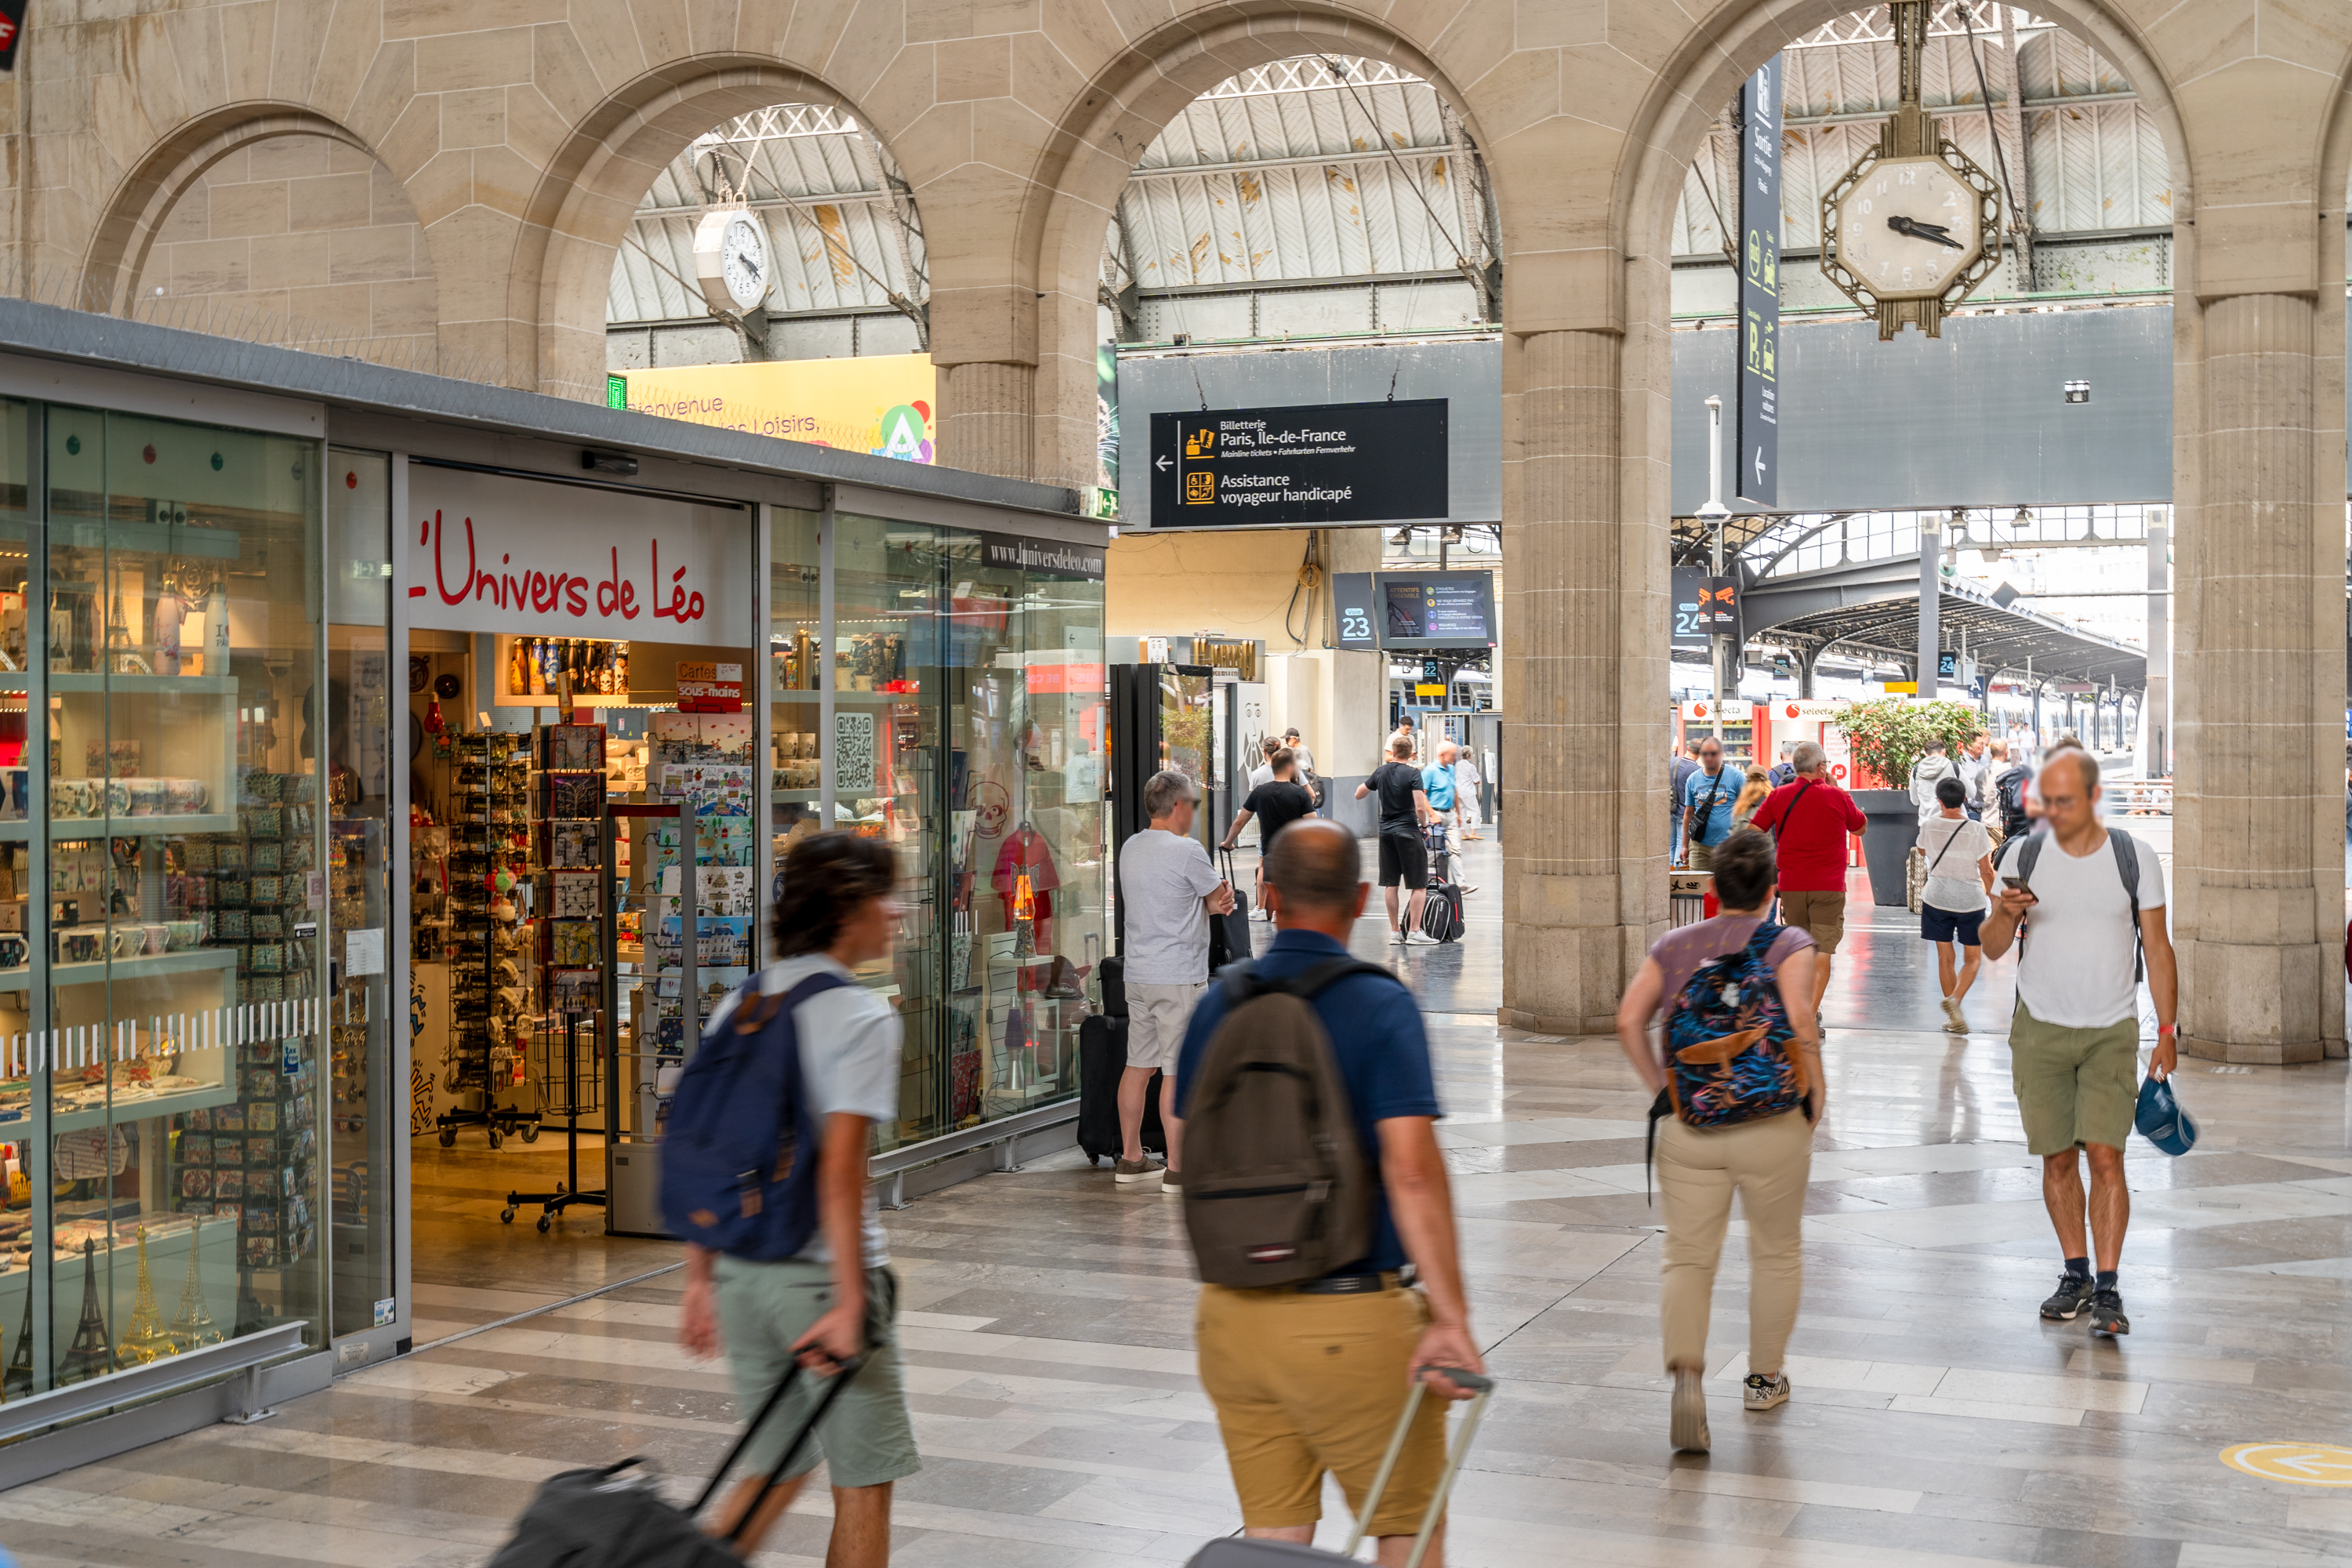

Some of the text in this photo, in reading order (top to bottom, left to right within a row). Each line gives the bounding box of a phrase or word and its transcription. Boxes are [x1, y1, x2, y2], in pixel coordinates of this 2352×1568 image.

[1898, 170, 1916, 186] 12
[1876, 180, 1888, 196] 11
[1857, 198, 1873, 215] 10
[1943, 191, 1956, 208] 2
[1852, 222, 1864, 238] 9
[1950, 216, 1963, 231] 3
[739, 225, 746, 238] 12
[727, 234, 734, 246] 10
[724, 249, 729, 260] 9
[752, 245, 757, 257] 2
[727, 264, 731, 276] 8
[1900, 266, 1913, 282] 6
[1924, 260, 1939, 275] 5
[739, 283, 743, 294] 6
[746, 282, 750, 294] 5
[753, 416, 820, 436] Loisirs,
[1220, 419, 1267, 430] Billetterie
[1220, 429, 1347, 448] Paris, Île-de-France
[1221, 445, 1356, 458] Mainline tickets Fahrkarten Fernverkehr
[1221, 474, 1290, 488] Assistance
[1221, 486, 1352, 506] voyageur handicapé
[408, 509, 705, 623] 'Univers de Léo
[990, 543, 1102, 574] www.luniversdeleo.com
[1342, 617, 1370, 637] 23
[680, 663, 717, 679] Cartes
[1425, 666, 1436, 675] 22
[1940, 661, 1954, 670] 24
[679, 685, 740, 698] sous-mains
[1970, 679, 1981, 691] A
[1011, 862, 1040, 898] PIS
[285, 1046, 296, 1054] tax
